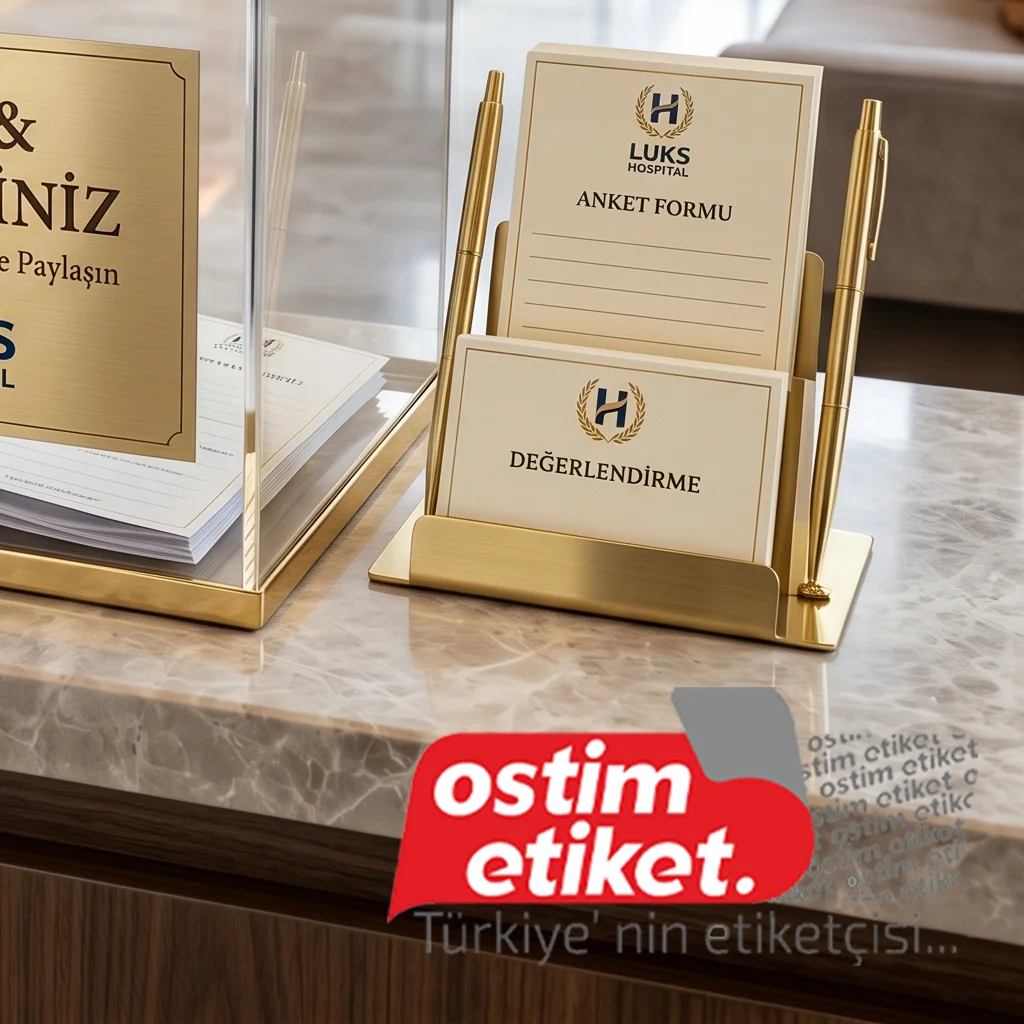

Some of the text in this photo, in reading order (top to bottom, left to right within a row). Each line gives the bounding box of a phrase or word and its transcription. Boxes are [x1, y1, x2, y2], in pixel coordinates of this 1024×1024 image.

[627, 162, 690, 178] HOSPITAL
[629, 142, 691, 166] LUKS
[576, 190, 734, 223] ANKET FORMU
[16, 251, 120, 290] Paylaşın
[509, 449, 702, 495] DEĞERLENDİRME
